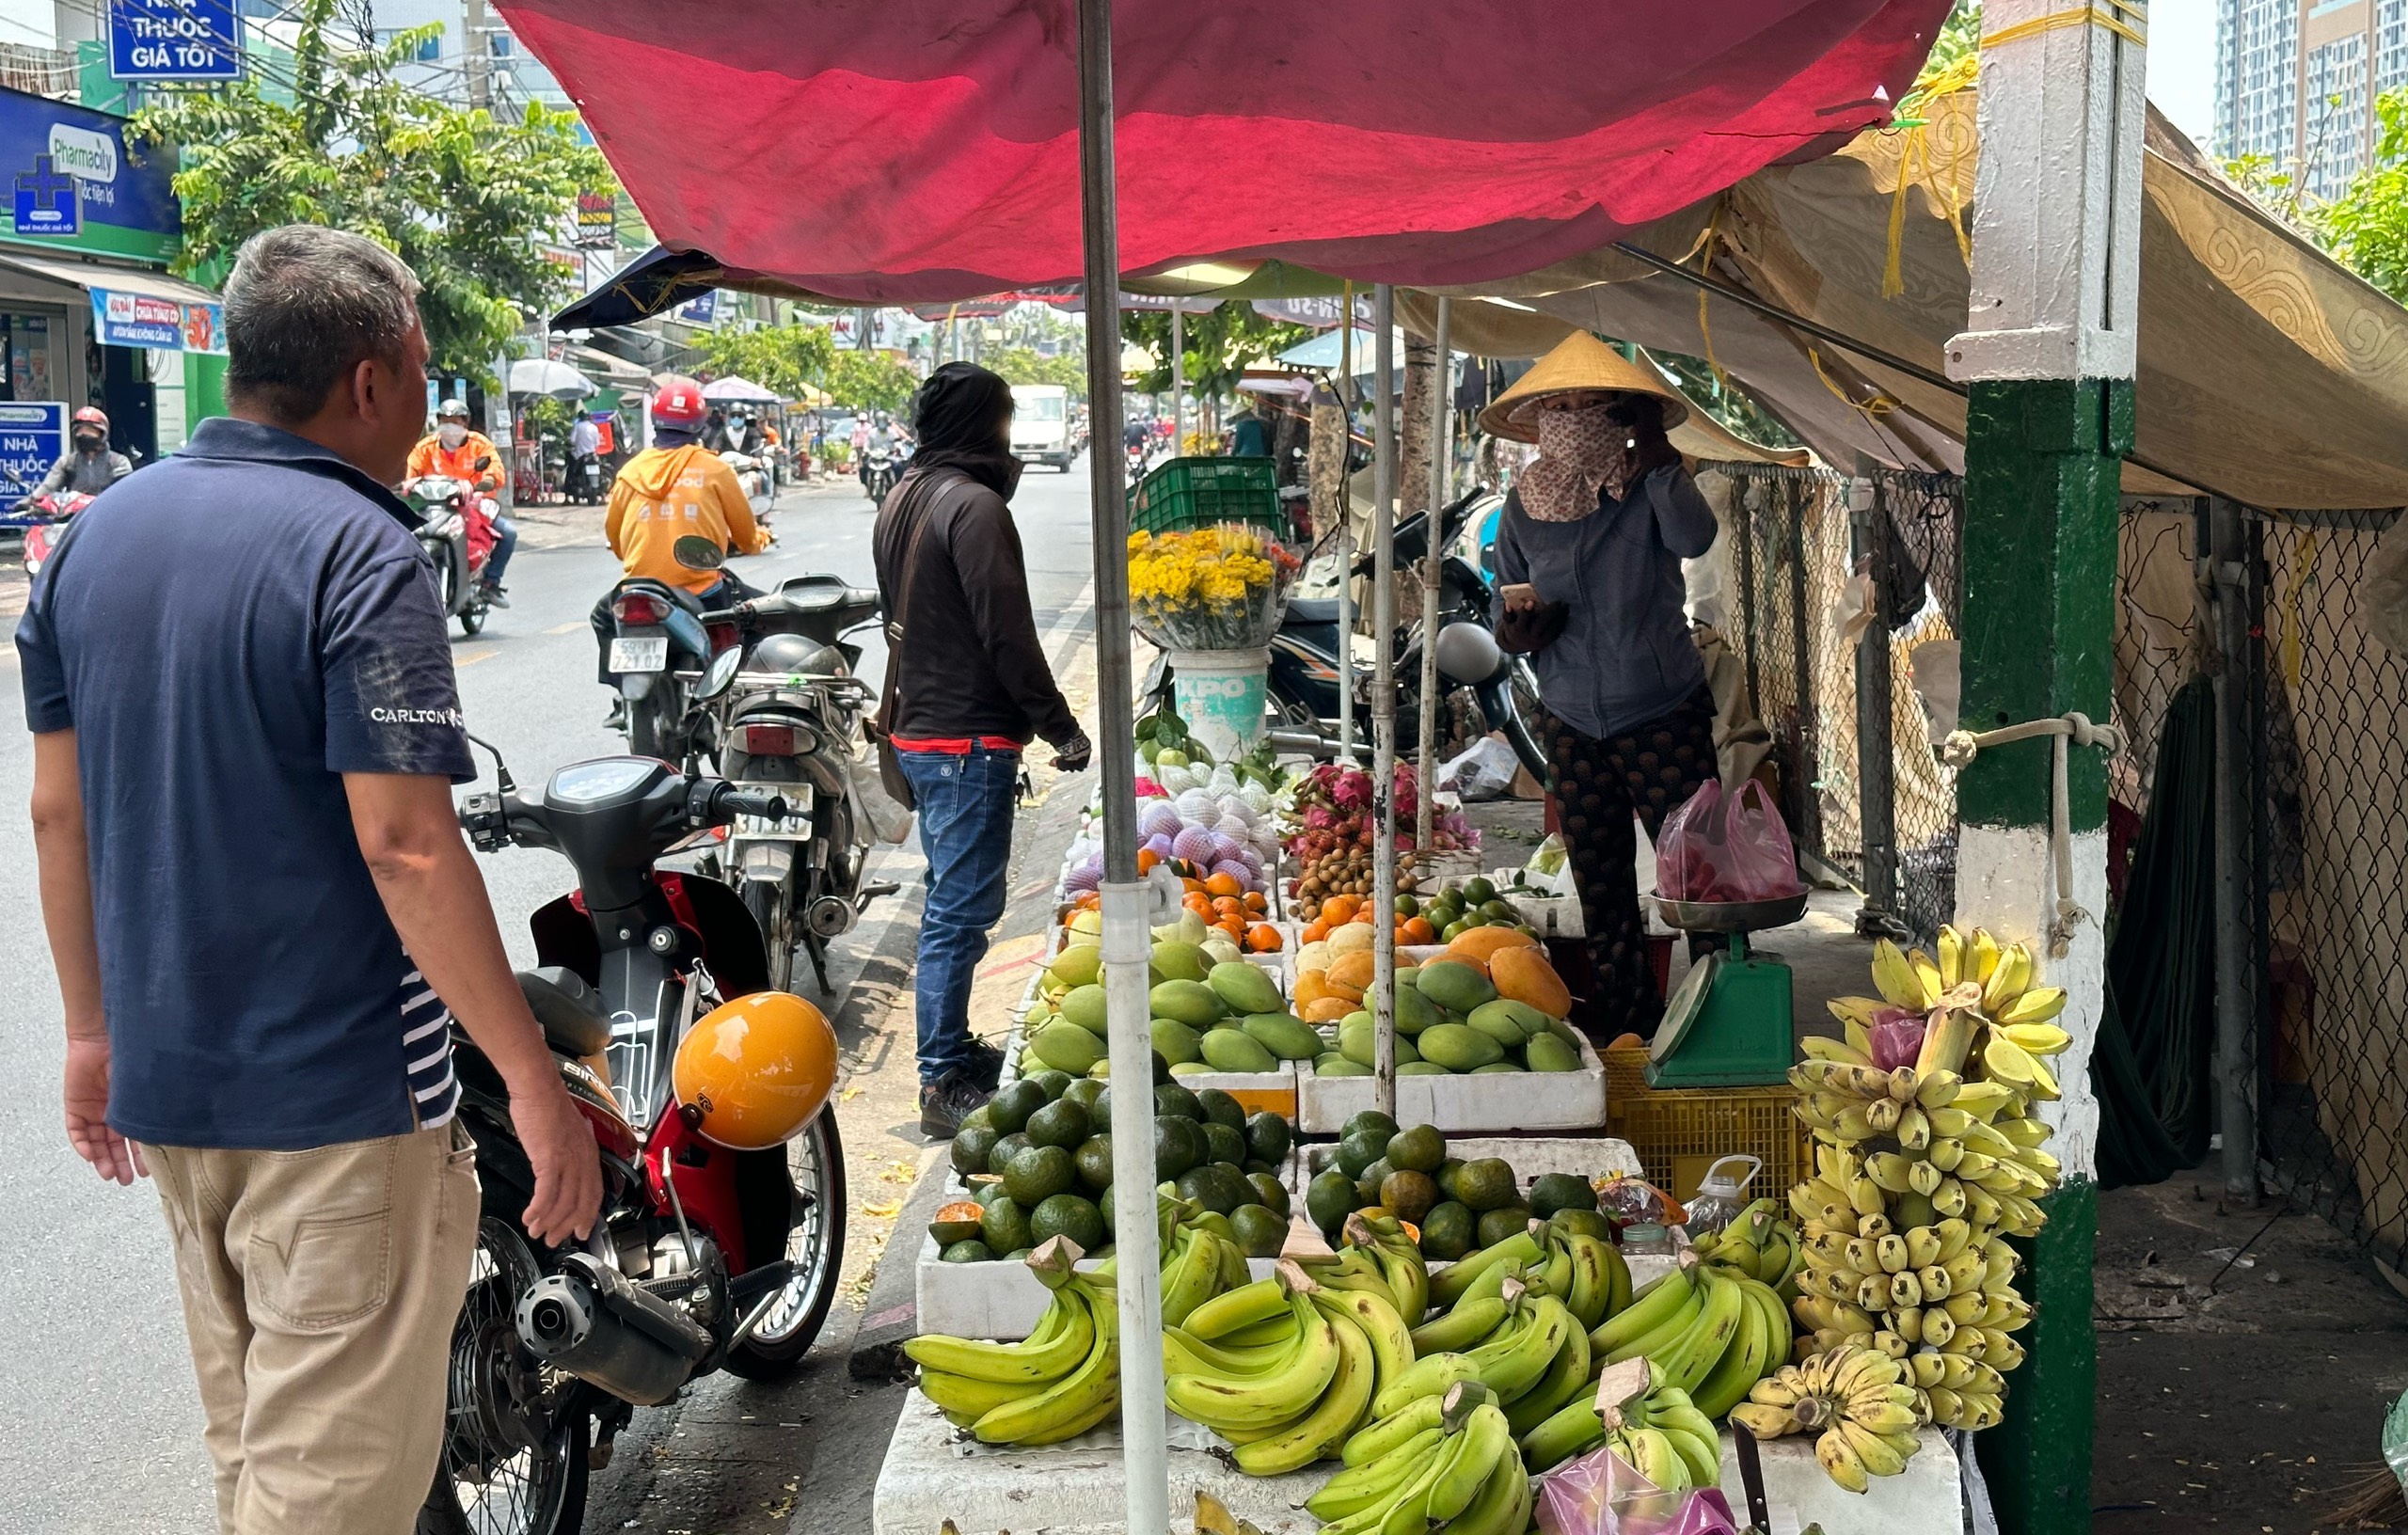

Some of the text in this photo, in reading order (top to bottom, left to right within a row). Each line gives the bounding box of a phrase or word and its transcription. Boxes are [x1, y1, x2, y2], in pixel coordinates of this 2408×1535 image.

[132, 42, 171, 68] GIÁ
[55, 137, 112, 179] Pharmacity
[4, 435, 39, 451] NHÀ
[371, 706, 447, 725] CARLTON
